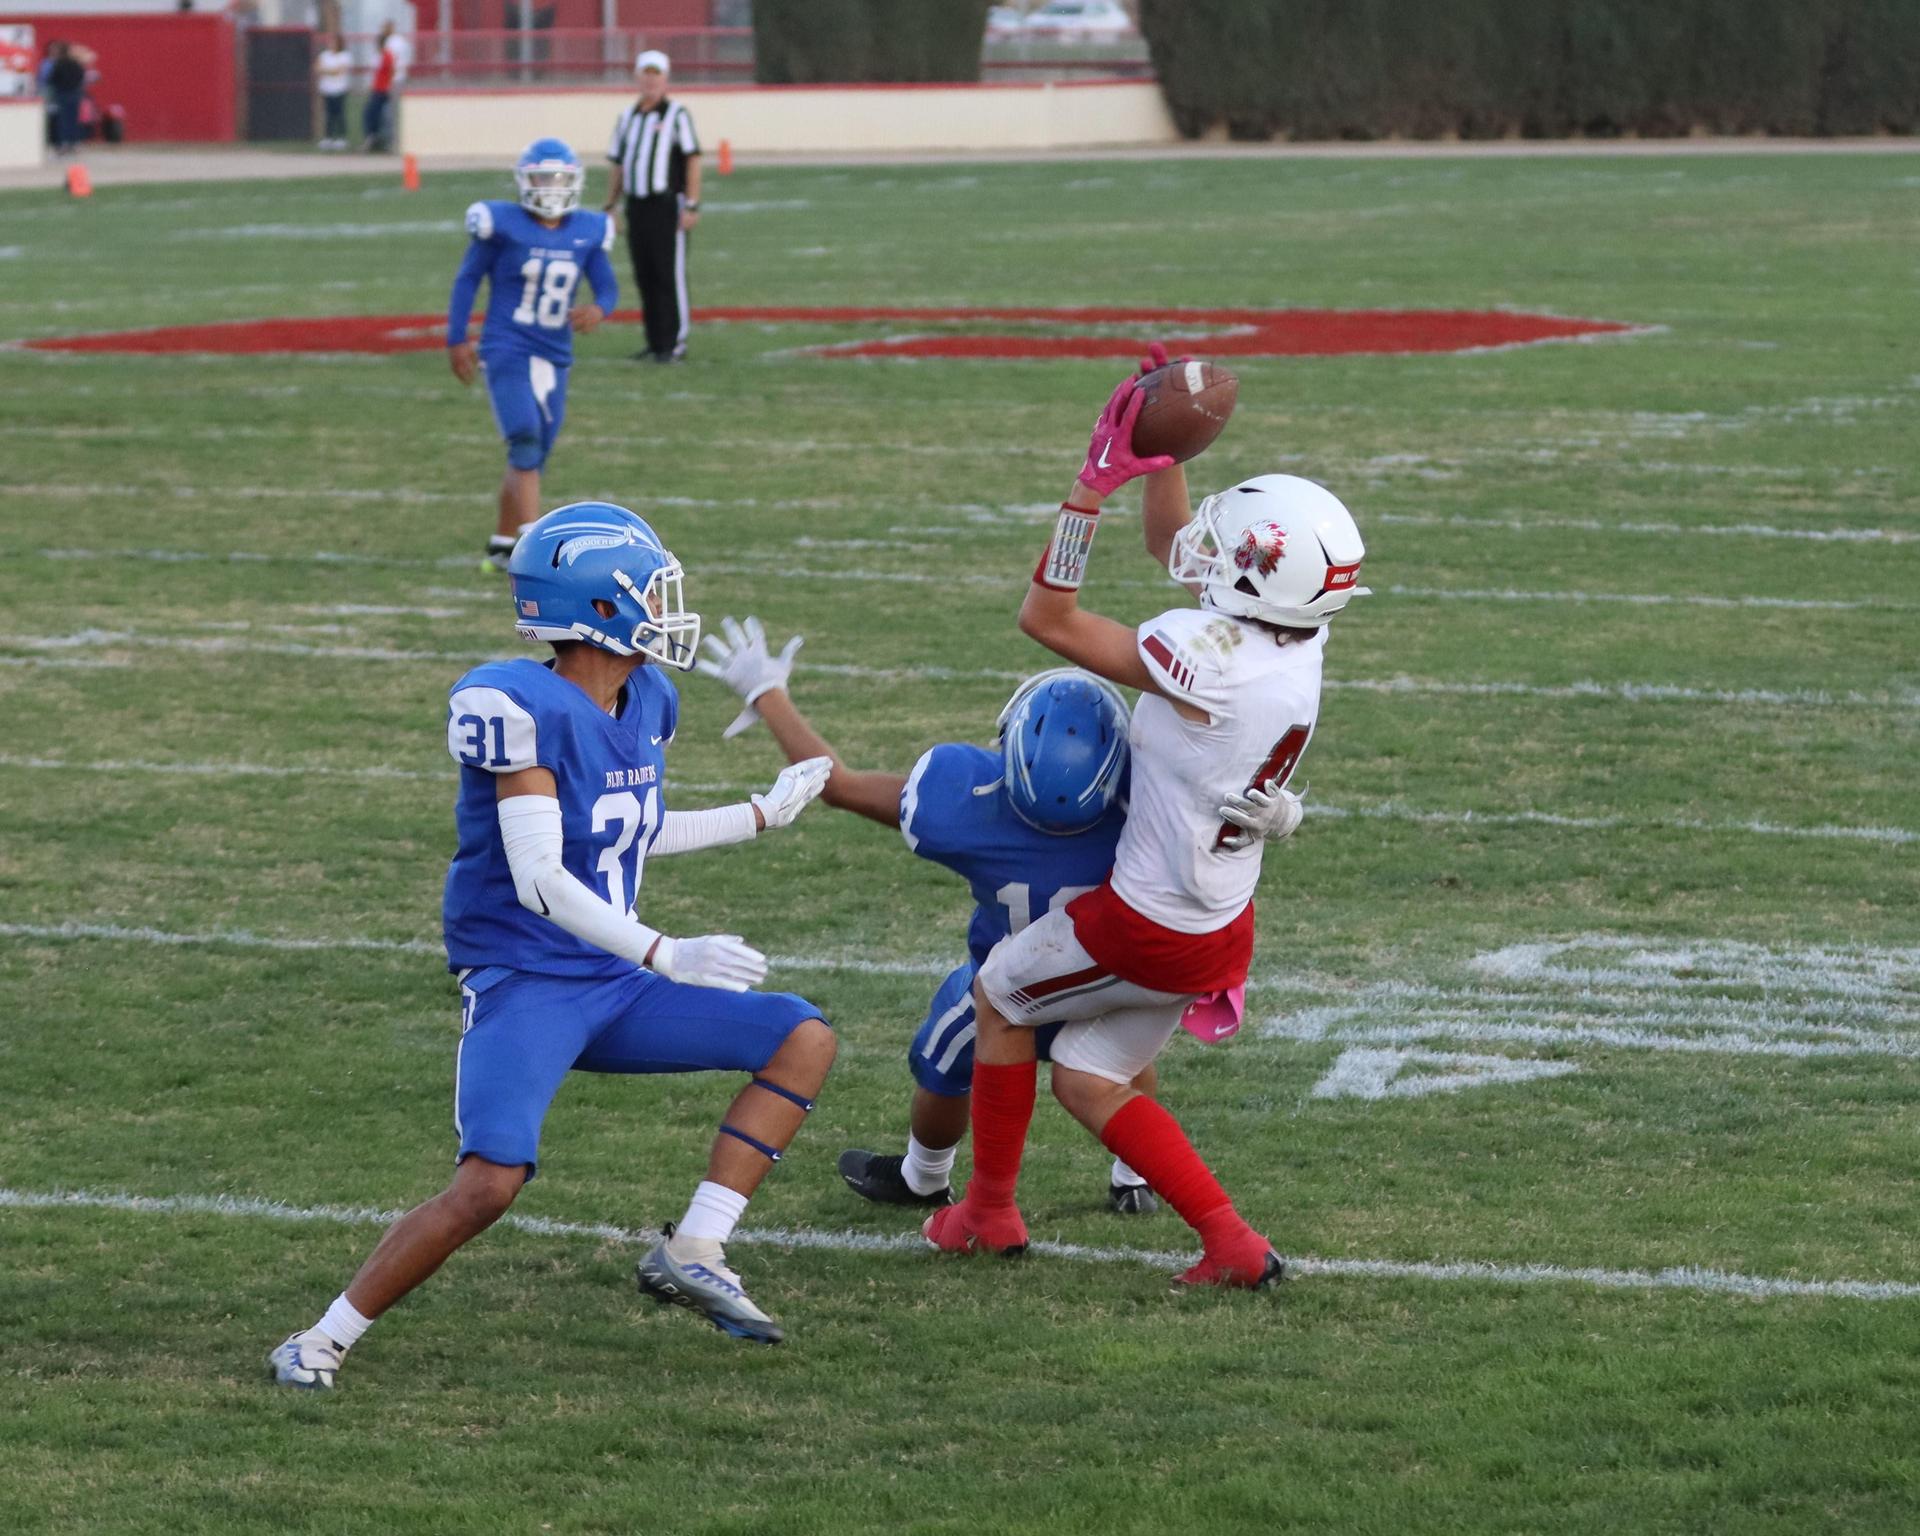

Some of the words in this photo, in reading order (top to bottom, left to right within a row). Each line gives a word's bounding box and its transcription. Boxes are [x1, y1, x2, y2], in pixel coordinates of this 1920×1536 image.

[512, 258, 579, 328] 18
[458, 713, 511, 767] 31
[605, 770, 625, 788] BLUE
[592, 786, 658, 922] 31
